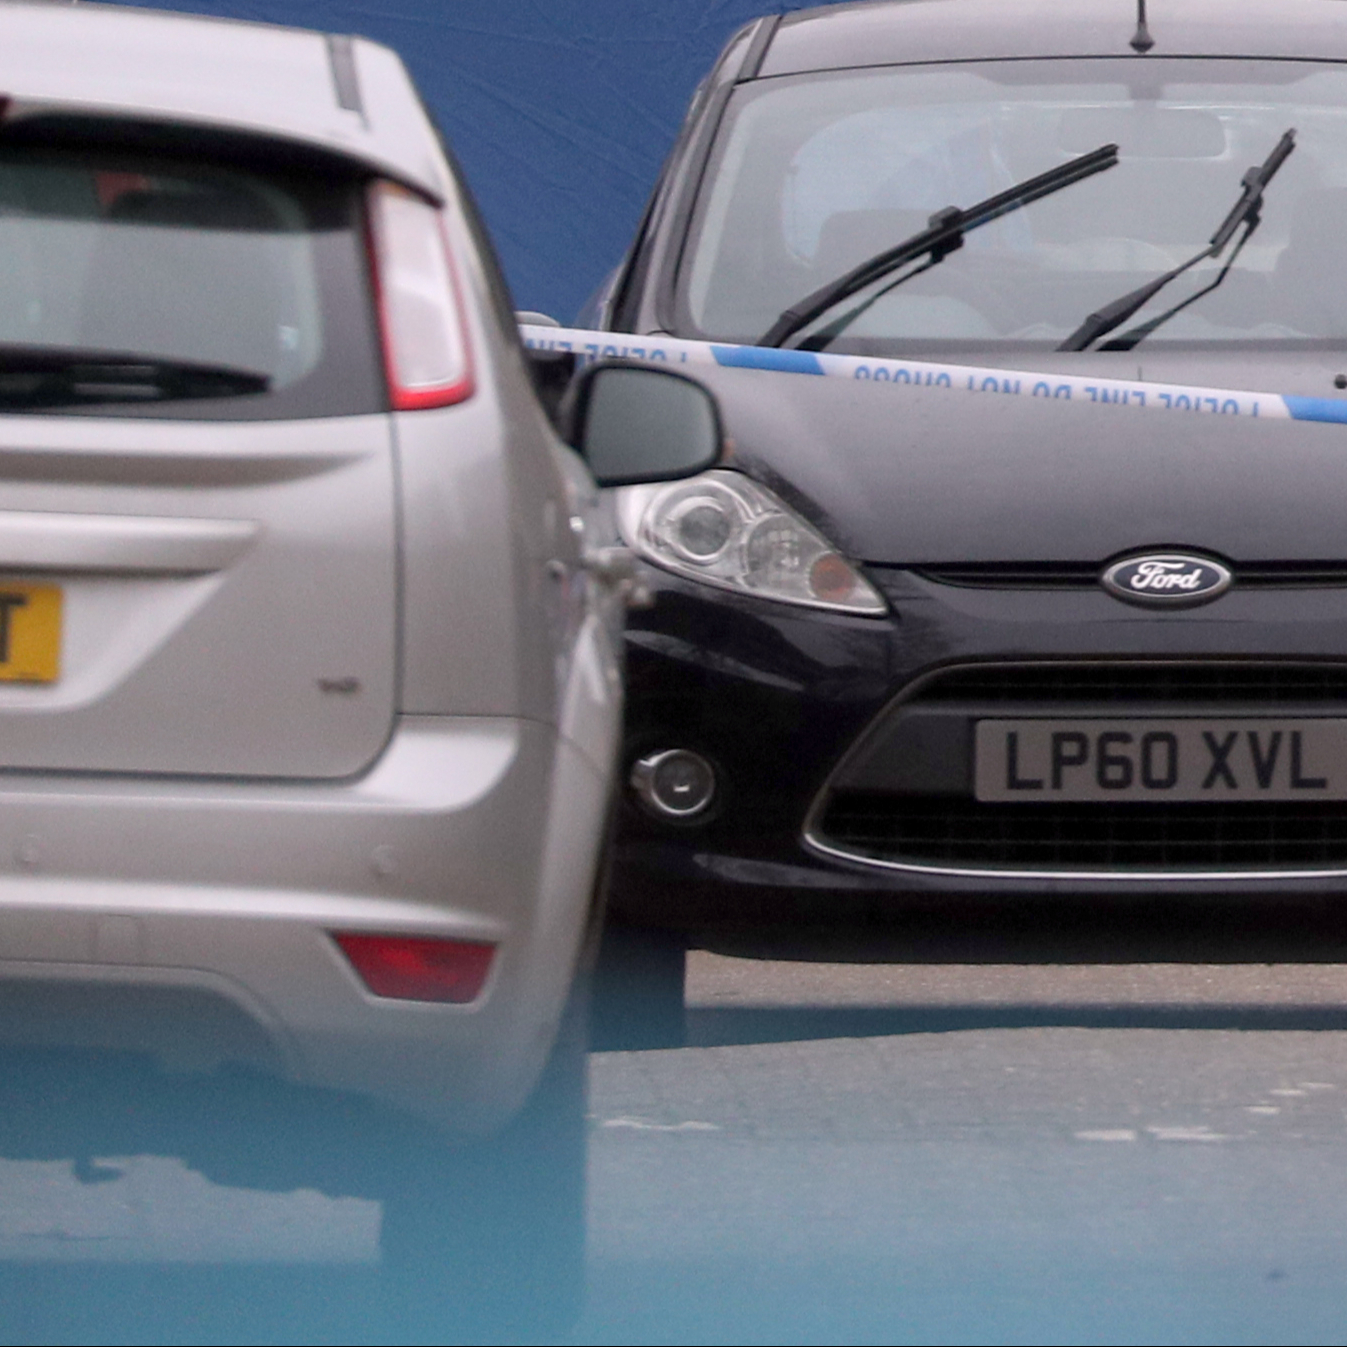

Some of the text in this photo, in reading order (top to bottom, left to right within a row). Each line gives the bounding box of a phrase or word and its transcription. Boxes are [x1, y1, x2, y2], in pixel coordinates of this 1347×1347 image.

[1130, 560, 1202, 590] Ford
[1005, 730, 1328, 791] LP60 XVL
